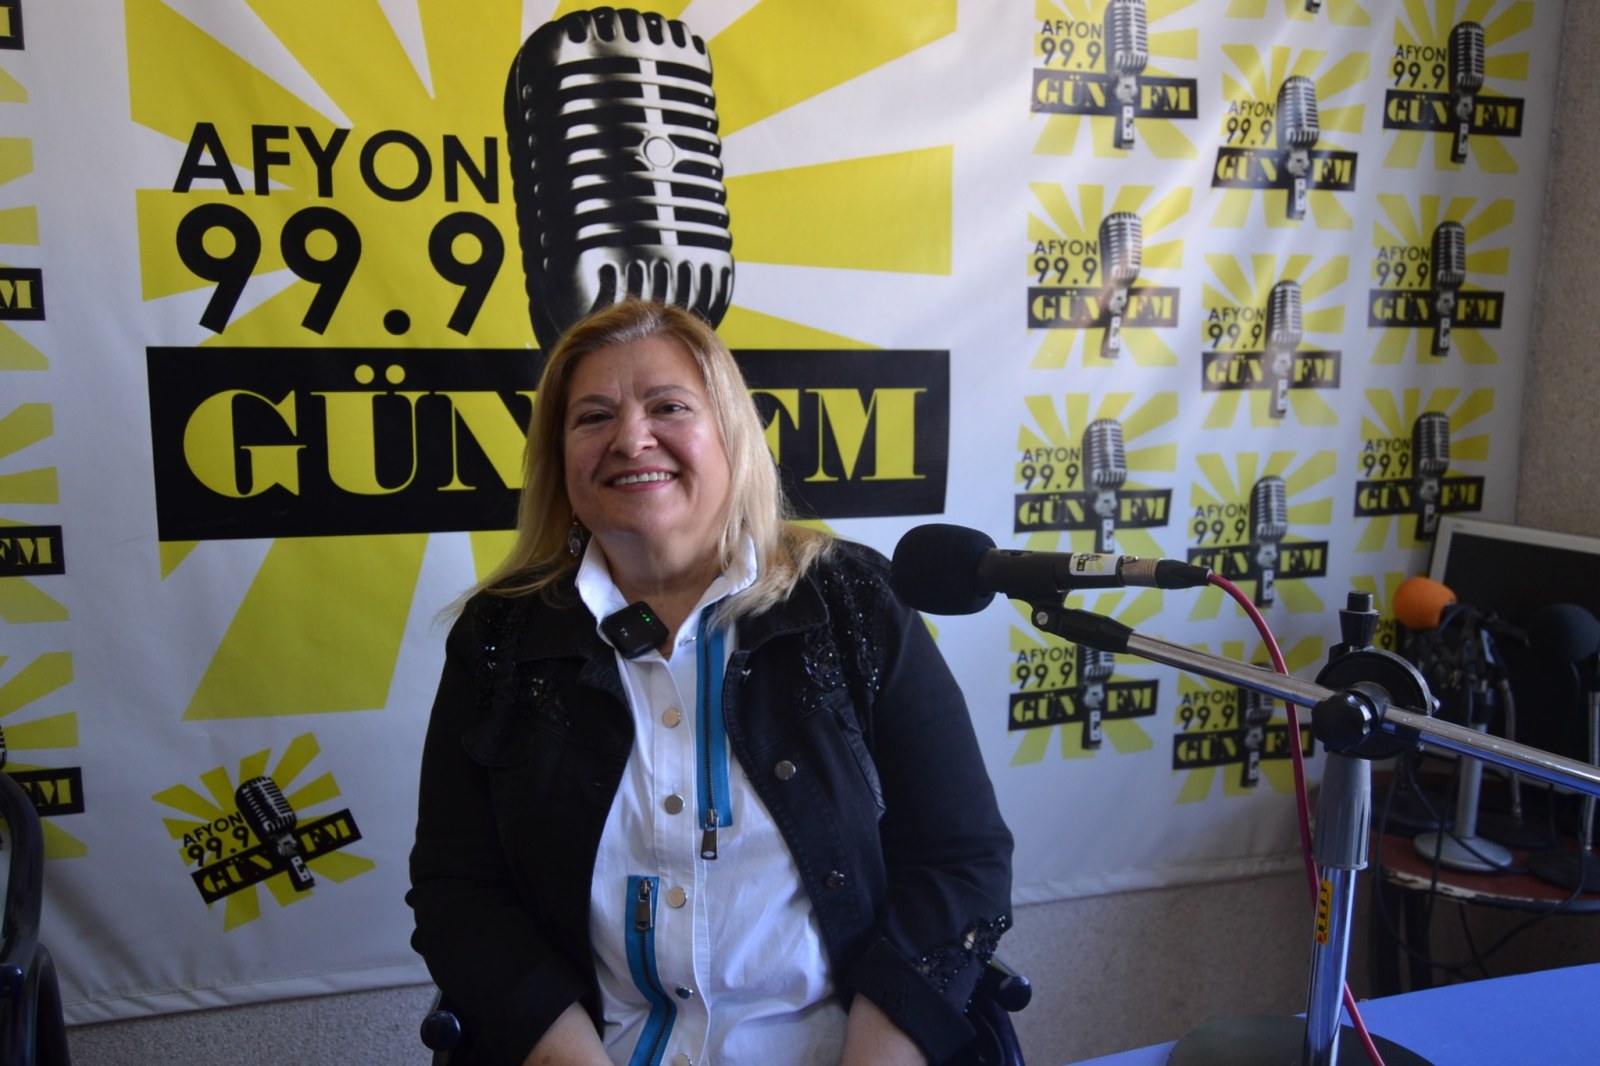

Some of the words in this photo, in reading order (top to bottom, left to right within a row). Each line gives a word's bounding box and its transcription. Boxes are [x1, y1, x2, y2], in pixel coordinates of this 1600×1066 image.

[1041, 20, 1102, 39] AFYON
[1041, 37, 1102, 69] 99.9
[1395, 44, 1447, 62] AFYON
[1393, 61, 1446, 89] 99.9
[1036, 74, 1108, 108] GÜN
[1140, 84, 1191, 111] FM
[1228, 100, 1275, 117] AFYON
[1387, 94, 1449, 124] GÜN
[1474, 104, 1517, 129] FM
[1226, 117, 1272, 145] 99.9
[172, 122, 500, 204] AFYON
[1216, 151, 1278, 182] GÜN
[1312, 158, 1352, 184] FM
[1034, 240, 1098, 256] AFYON
[1377, 246, 1431, 261] AFYON
[176, 203, 505, 336] 99.9
[1034, 257, 1098, 285] 99.9
[1377, 262, 1429, 287] 99.9
[1032, 290, 1103, 321] GÜN
[1127, 295, 1174, 320] FM
[1208, 307, 1265, 322] AFYON
[1373, 293, 1430, 321] GÜN
[1456, 298, 1497, 321] FM
[1208, 323, 1263, 349] 99.9
[1206, 355, 1265, 385] GÜN
[1294, 358, 1335, 382] FM
[183, 364, 537, 498] GÜN
[1364, 437, 1411, 452] AFYON
[1022, 447, 1082, 463] AFYON
[1363, 453, 1410, 477] 99.9
[1021, 463, 1079, 490] 99.9
[1018, 494, 1087, 526] GÜN
[1119, 497, 1167, 522] FM
[1358, 483, 1412, 510] GÜN
[1440, 484, 1477, 506] FM
[1195, 503, 1248, 518] AFYON
[1194, 518, 1246, 544] 99.9
[1279, 549, 1323, 572] FM
[1016, 647, 1075, 664] AFYON
[1016, 662, 1073, 689] 99.9
[1013, 693, 1077, 723] GÜN
[1107, 688, 1154, 713] FM
[1182, 690, 1236, 705] AFYON
[1180, 705, 1235, 731] 99.9
[1177, 734, 1238, 762] GÜN
[183, 812, 244, 847] AFYON
[187, 826, 249, 867] 99.9
[202, 854, 274, 893] GÜN
[301, 818, 352, 853] FM
